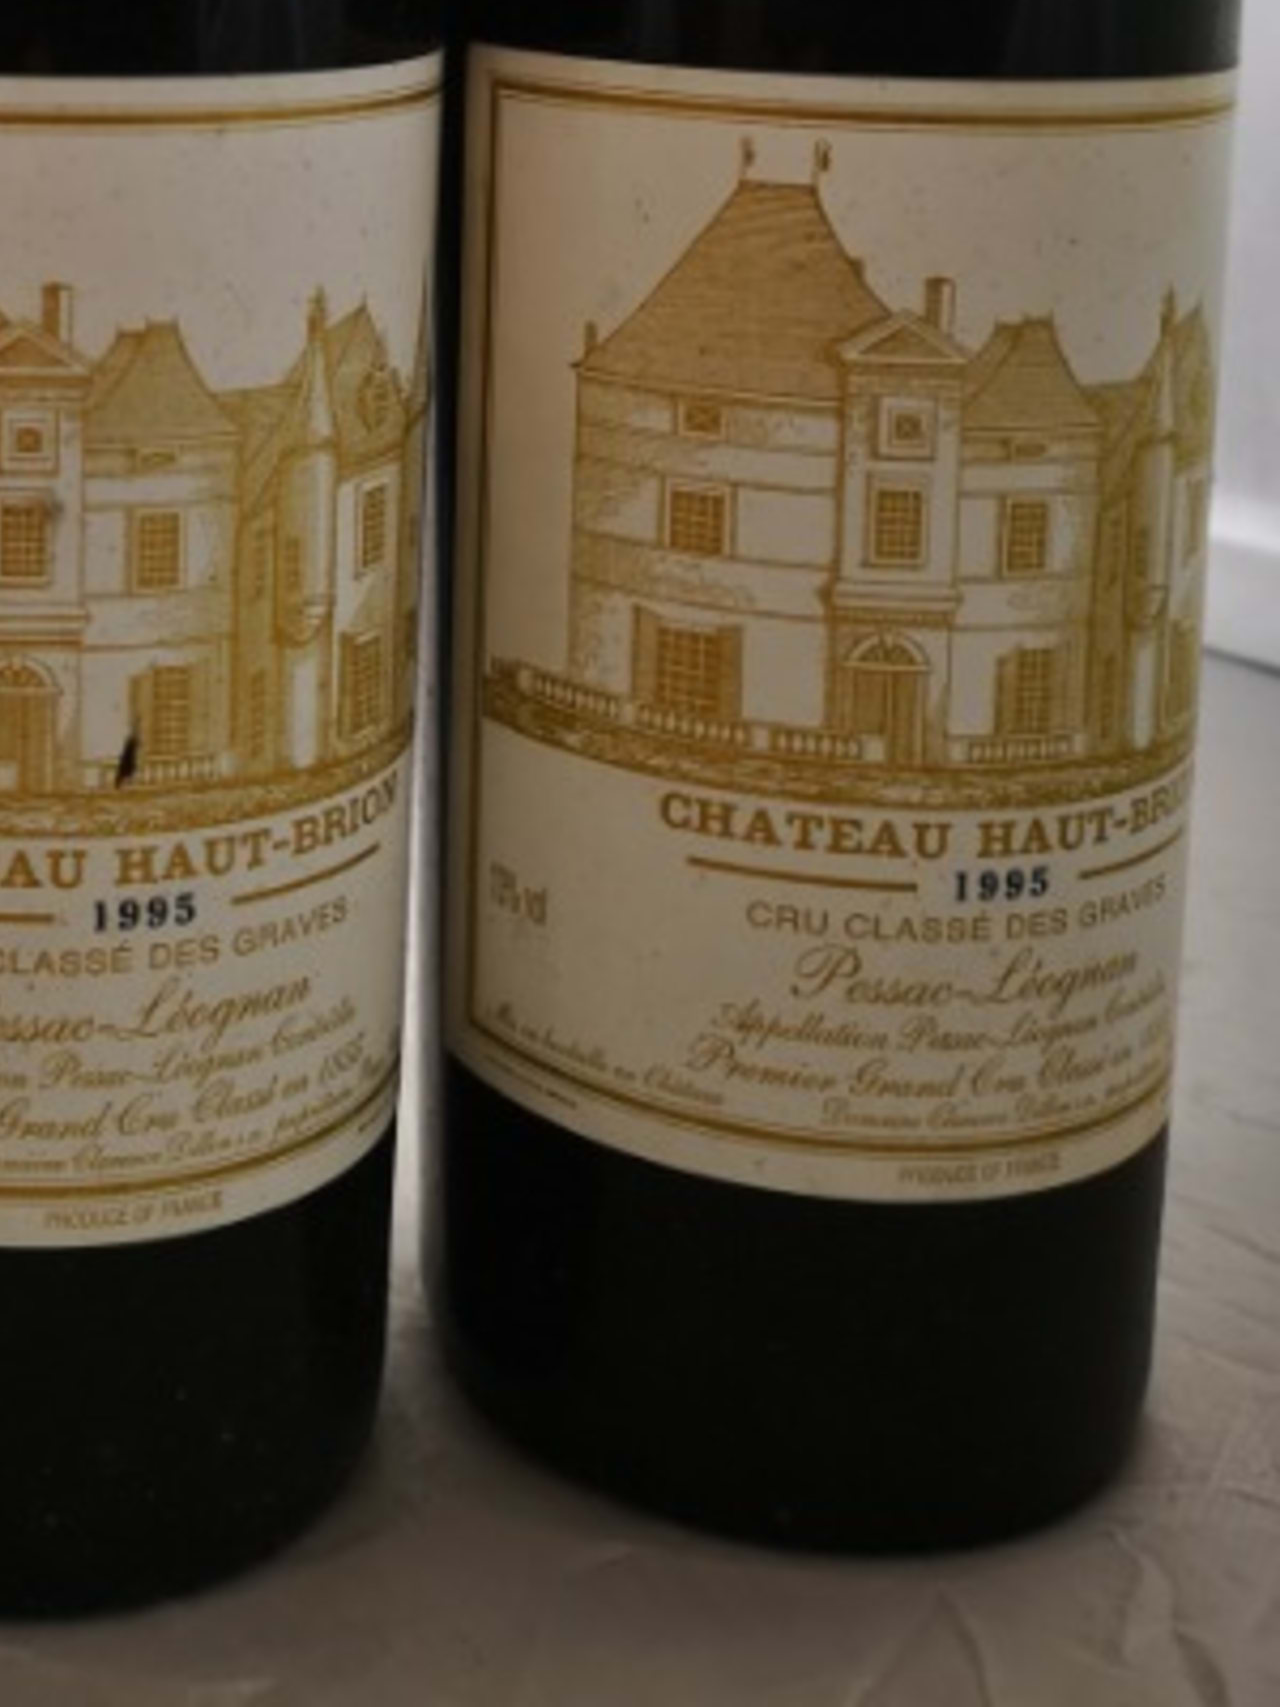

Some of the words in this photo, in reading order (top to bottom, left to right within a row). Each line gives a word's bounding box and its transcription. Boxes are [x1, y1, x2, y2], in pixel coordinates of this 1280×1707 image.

[114, 770, 399, 886] HAUT-BRION
[659, 792, 954, 860] CHATEAU
[954, 864, 1051, 903] 1995
[92, 891, 198, 934] 1995
[147, 935, 221, 971] DES
[231, 895, 349, 958] GRAVES
[745, 899, 829, 936] CRU
[843, 908, 992, 944] CLASSÉ
[1005, 907, 1068, 940] DES
